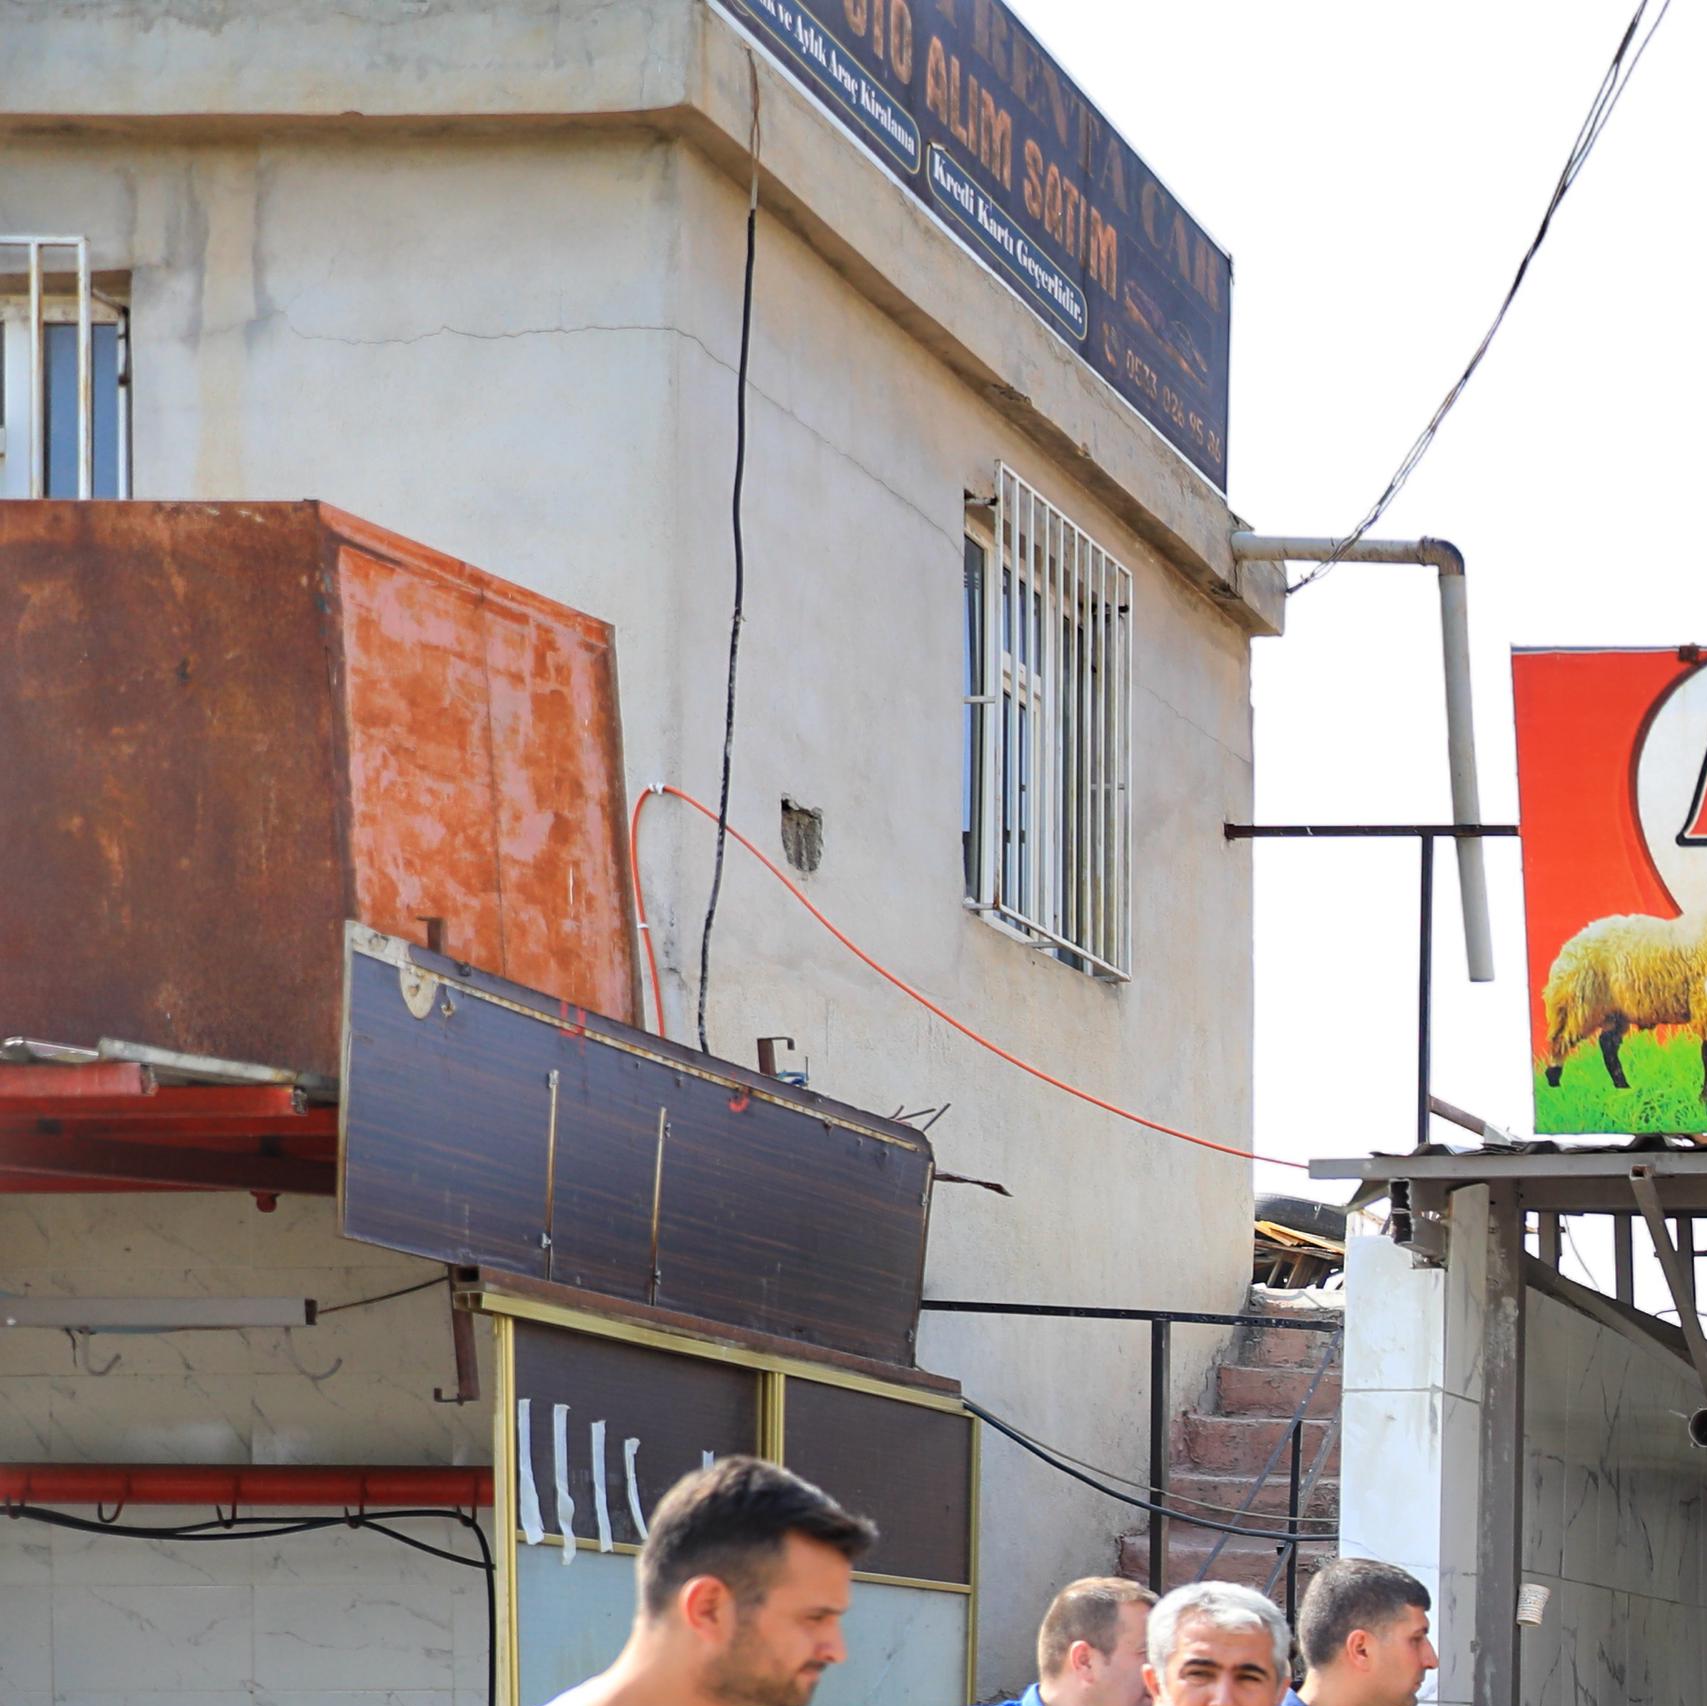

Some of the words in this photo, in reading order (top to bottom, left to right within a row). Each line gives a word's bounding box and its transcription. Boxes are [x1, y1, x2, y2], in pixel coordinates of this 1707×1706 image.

[828, 49, 858, 104] Araç
[859, 79, 916, 156] Kiralama
[926, 35, 1012, 192] ALIM
[1023, 138, 1118, 301] SATIM
[933, 150, 975, 216] Kredi
[977, 195, 1014, 254] Kartı
[1015, 237, 1083, 325] Geçerlidir.
[1141, 179, 1221, 313] CAR
